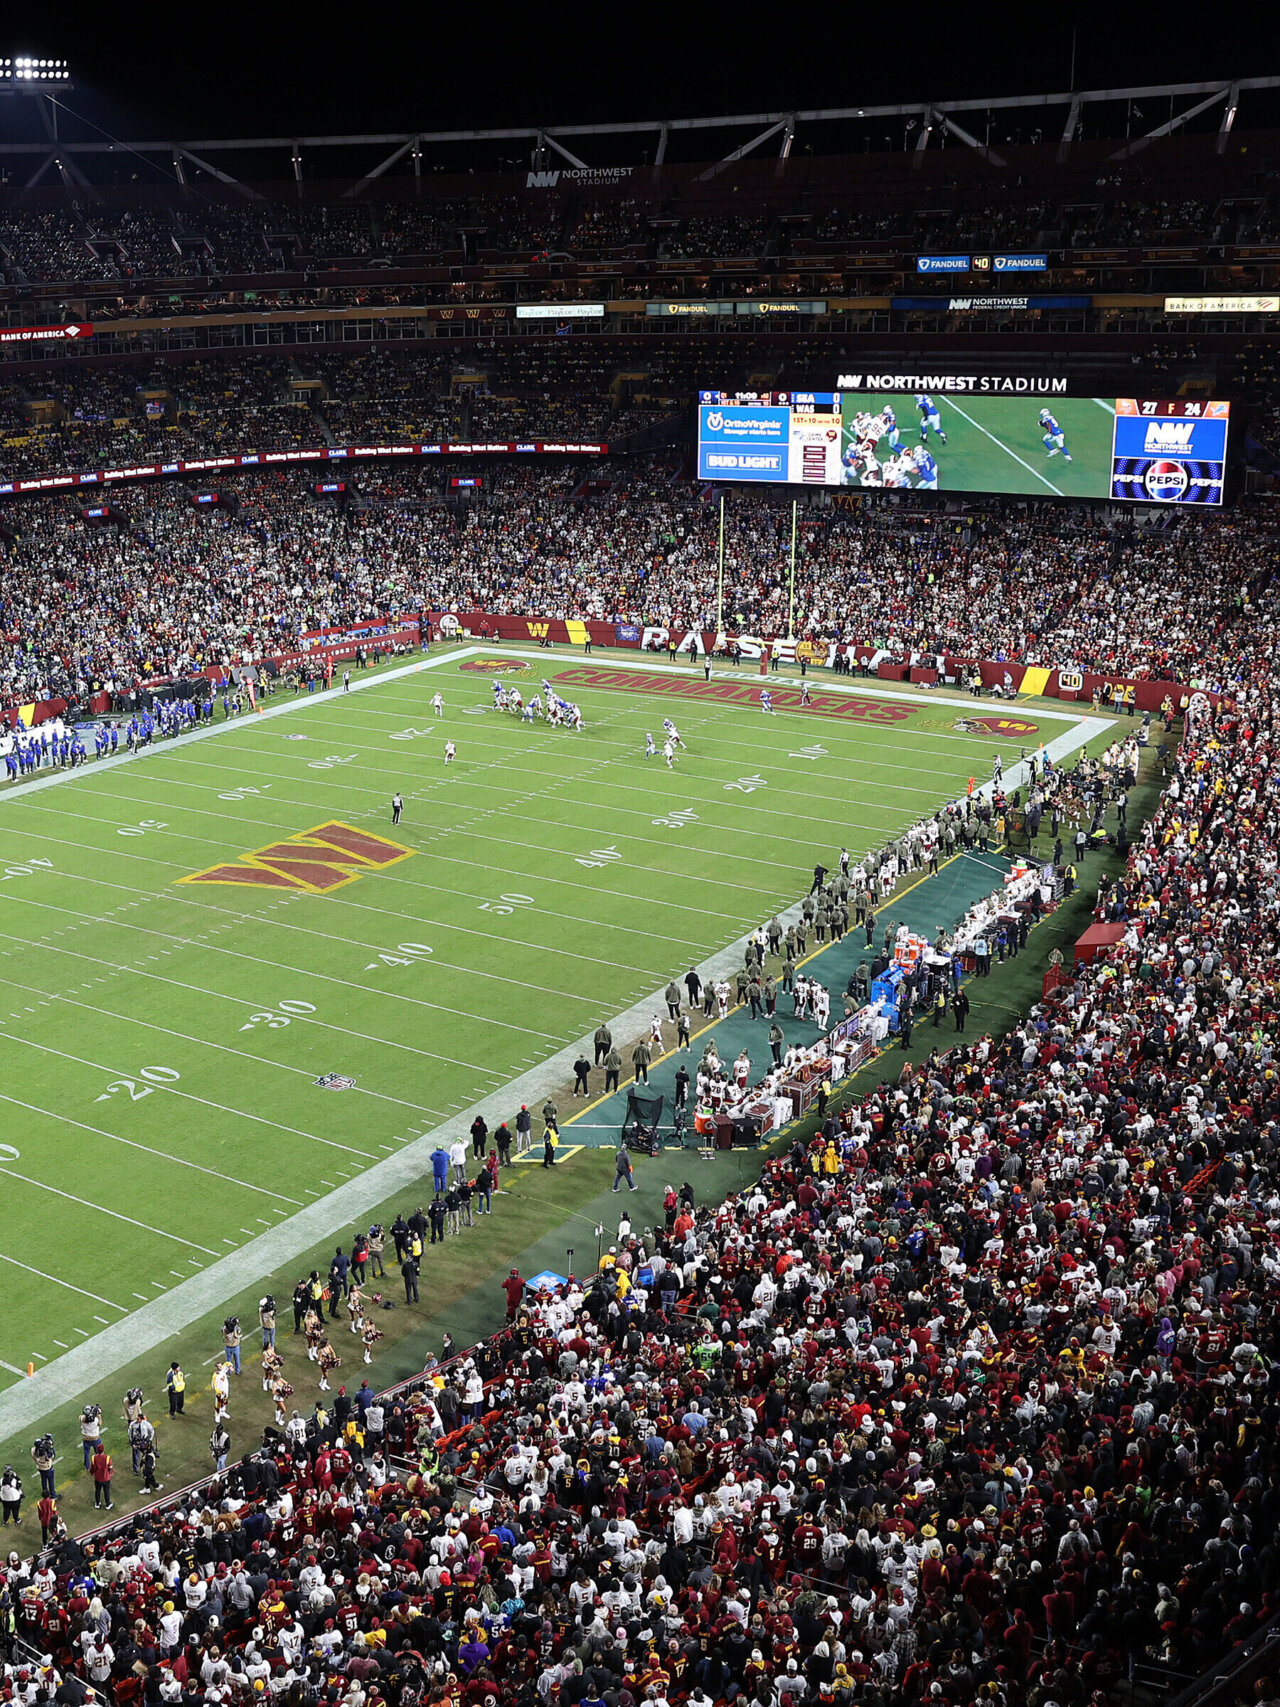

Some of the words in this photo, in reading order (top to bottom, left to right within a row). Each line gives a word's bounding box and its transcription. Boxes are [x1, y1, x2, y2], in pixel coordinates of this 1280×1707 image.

[526, 170, 560, 188] NW
[562, 167, 634, 179] NORTHWEST
[576, 177, 620, 187] STADIUM
[930, 260, 968, 268] FANDUEL
[974, 258, 988, 269] 40
[1007, 259, 1046, 267] FANDUEL
[948, 298, 972, 310] NW
[1, 333, 22, 342] BANK
[22, 332, 32, 340] OF
[32, 330, 65, 339] AMERICA
[836, 374, 862, 388] NW
[866, 375, 977, 391] NORTHWEST
[979, 376, 1067, 392] STADIUM
[795, 393, 815, 403] SEA
[795, 404, 815, 414] WAS
[1141, 401, 1158, 415] 27
[1167, 403, 1175, 414] F
[1184, 402, 1201, 416] 24
[1144, 421, 1195, 444] NW
[1144, 443, 1194, 451] NORTHWEST
[708, 455, 737, 468] BUD
[738, 456, 779, 469] LIGHT
[1113, 473, 1144, 484] PEPSI
[1148, 475, 1184, 486] PEPSI
[1062, 675, 1079, 687] 40
[551, 668, 918, 723] COMMANDERS
[388, 727, 432, 740] 20
[788, 746, 829, 760] 10
[307, 755, 352, 769] 30
[722, 777, 768, 794] 20
[217, 786, 261, 801] 40
[651, 811, 700, 828] 30
[116, 820, 169, 836] 50
[574, 849, 623, 868] 40
[3, 857, 54, 876] 40
[476, 893, 535, 915] 50
[377, 942, 434, 967] 40
[249, 1000, 317, 1028] 30
[106, 1066, 181, 1101] 20
[294, 1429, 304, 1439] 81
[282, 1528, 294, 1541] 47
[803, 1537, 817, 1549] 29
[40, 1582, 52, 1592] 21
[24, 1608, 37, 1620] 17
[345, 1618, 358, 1630] 91
